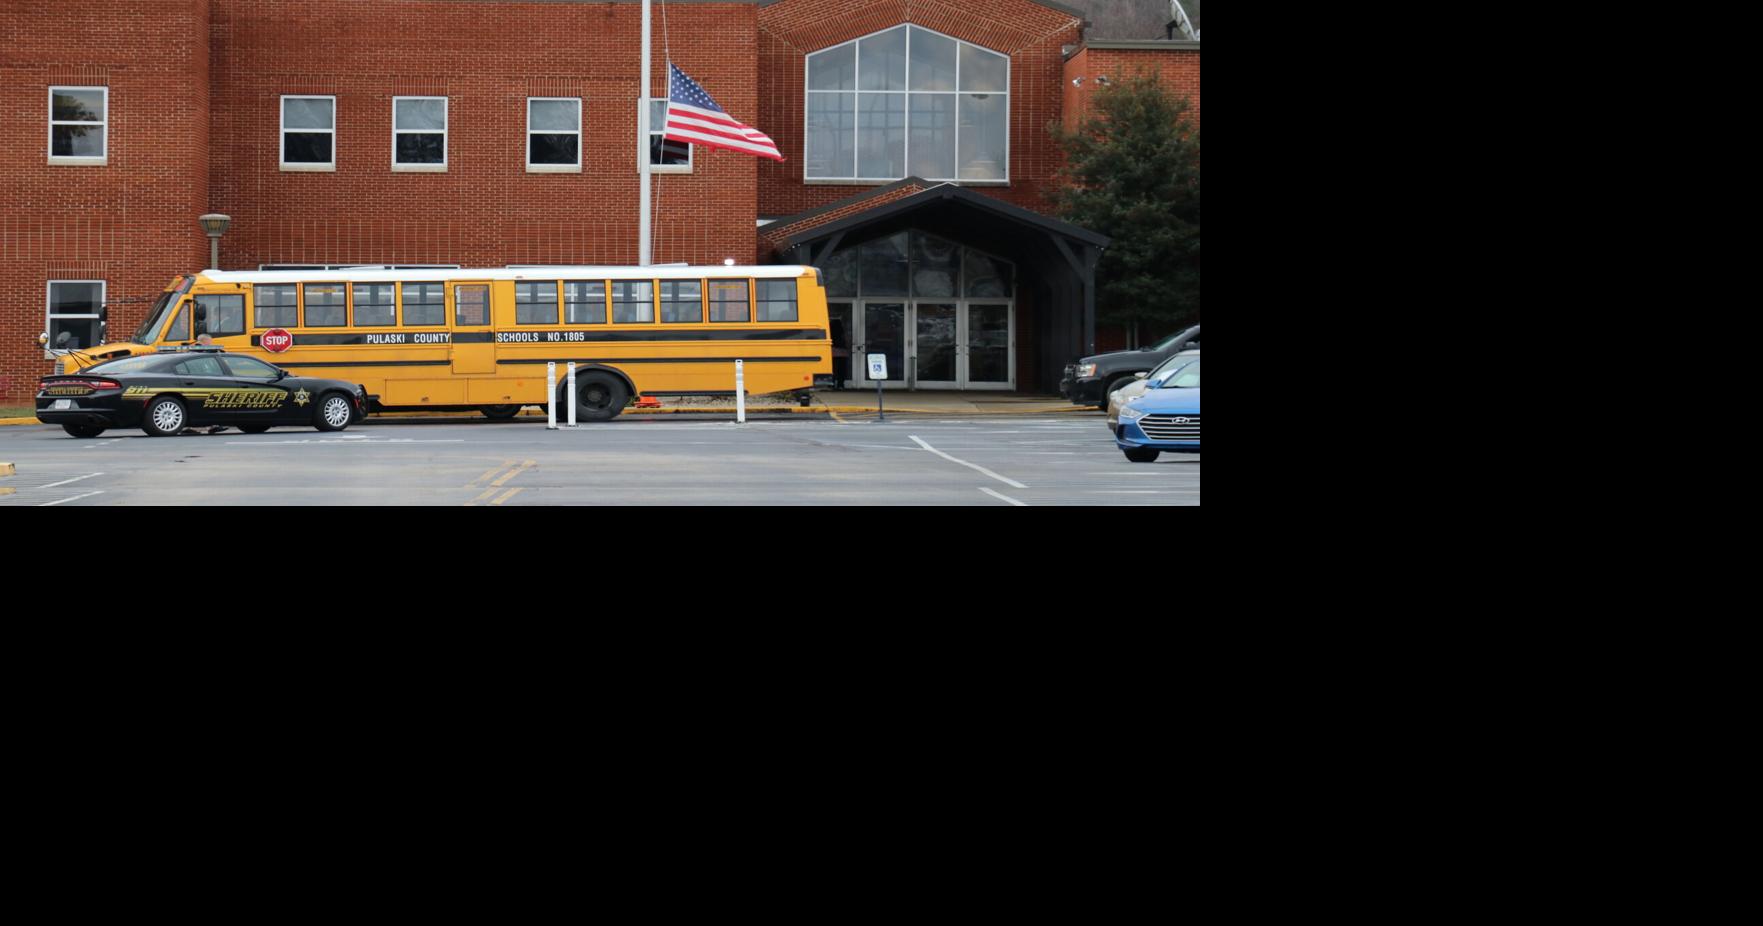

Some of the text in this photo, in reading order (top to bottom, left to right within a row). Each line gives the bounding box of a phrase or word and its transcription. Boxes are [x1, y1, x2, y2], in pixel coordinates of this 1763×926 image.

[266, 336, 288, 345] STOP
[367, 332, 585, 344] PULASKI COUNTY SCHOOLS NO.1805
[205, 391, 288, 404] SHERIFF
